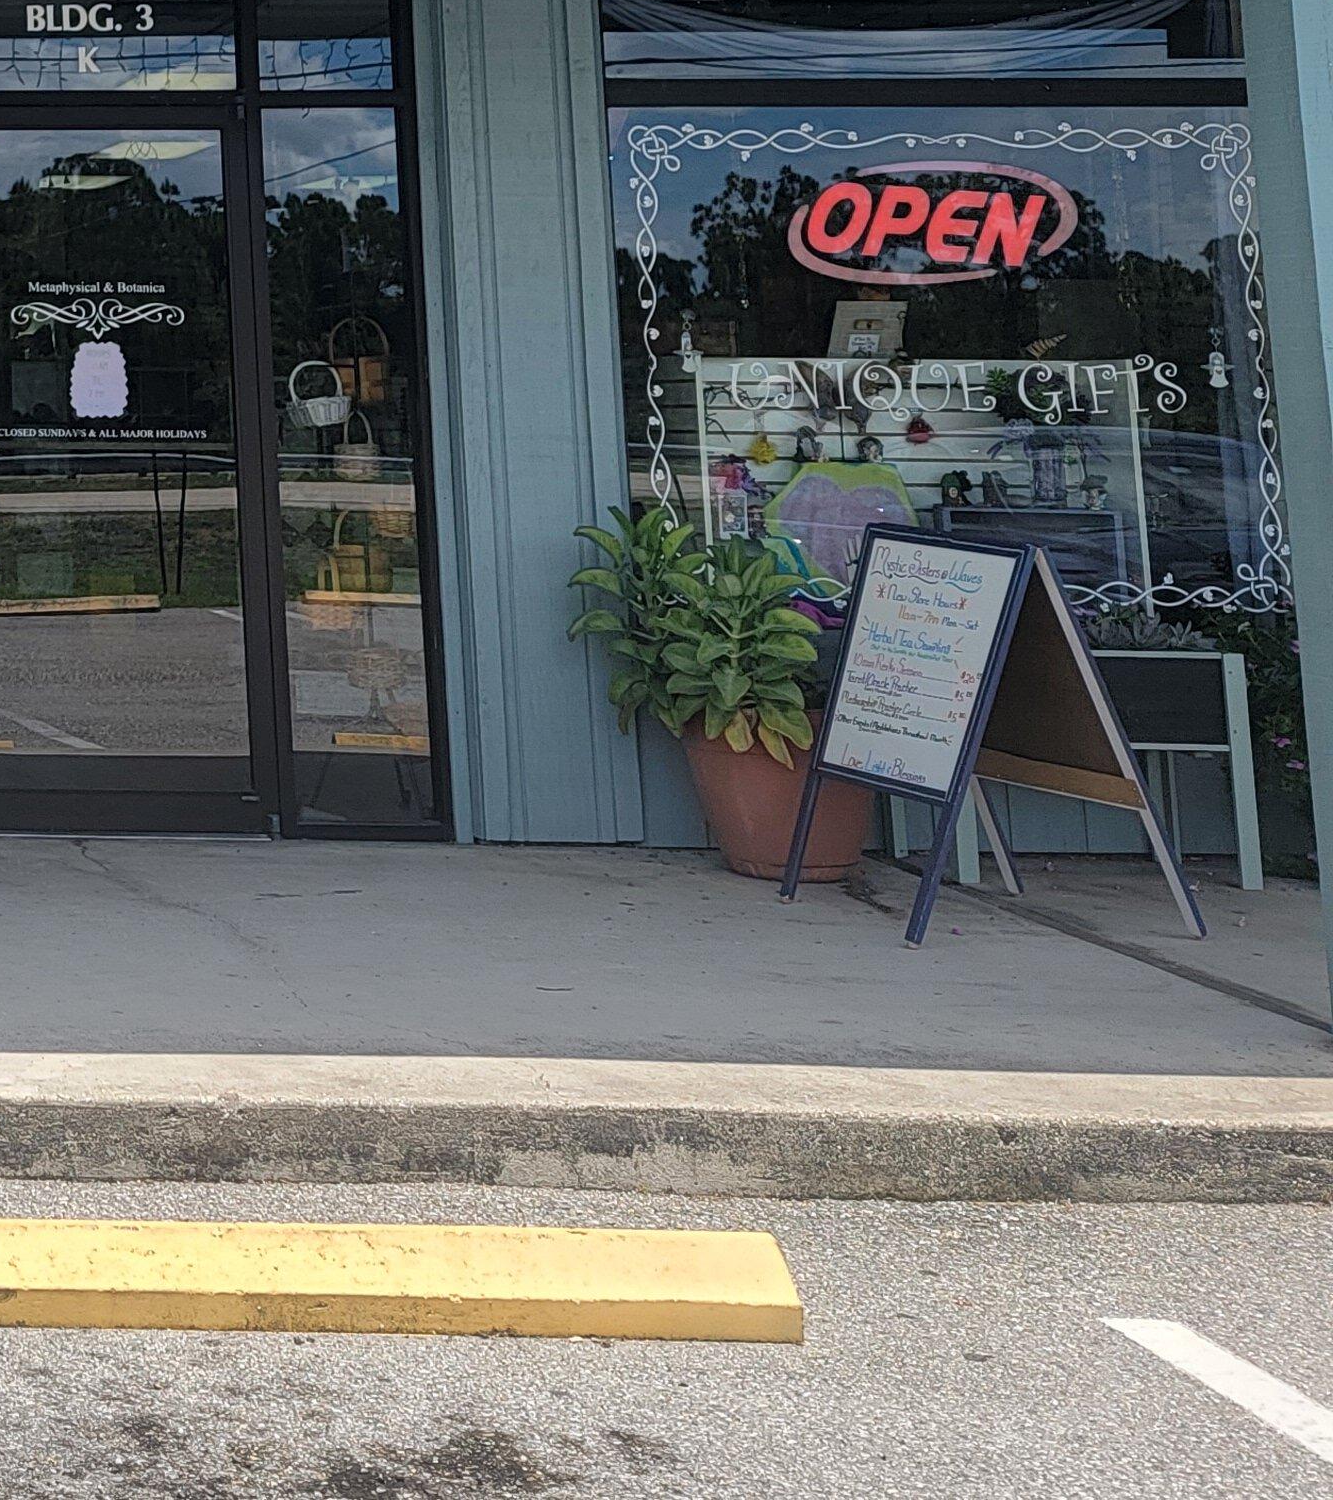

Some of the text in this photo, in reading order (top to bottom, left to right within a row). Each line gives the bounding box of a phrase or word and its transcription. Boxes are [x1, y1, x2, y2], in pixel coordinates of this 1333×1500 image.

[26, 3, 154, 32] BLDG. 3
[78, 46, 101, 73] K
[807, 181, 1047, 268] OPEN
[28, 282, 165, 295] Metaphysical & Botanica
[730, 353, 1187, 425] UNIQUE GIFTS
[88, 429, 97, 438] &
[99, 429, 118, 438] ALL
[121, 429, 154, 438] MAJOR
[156, 429, 207, 439] HOLIDAYS
[872, 546, 907, 579] Mystic
[908, 550, 941, 580] Sisters
[948, 560, 983, 584] Waves
